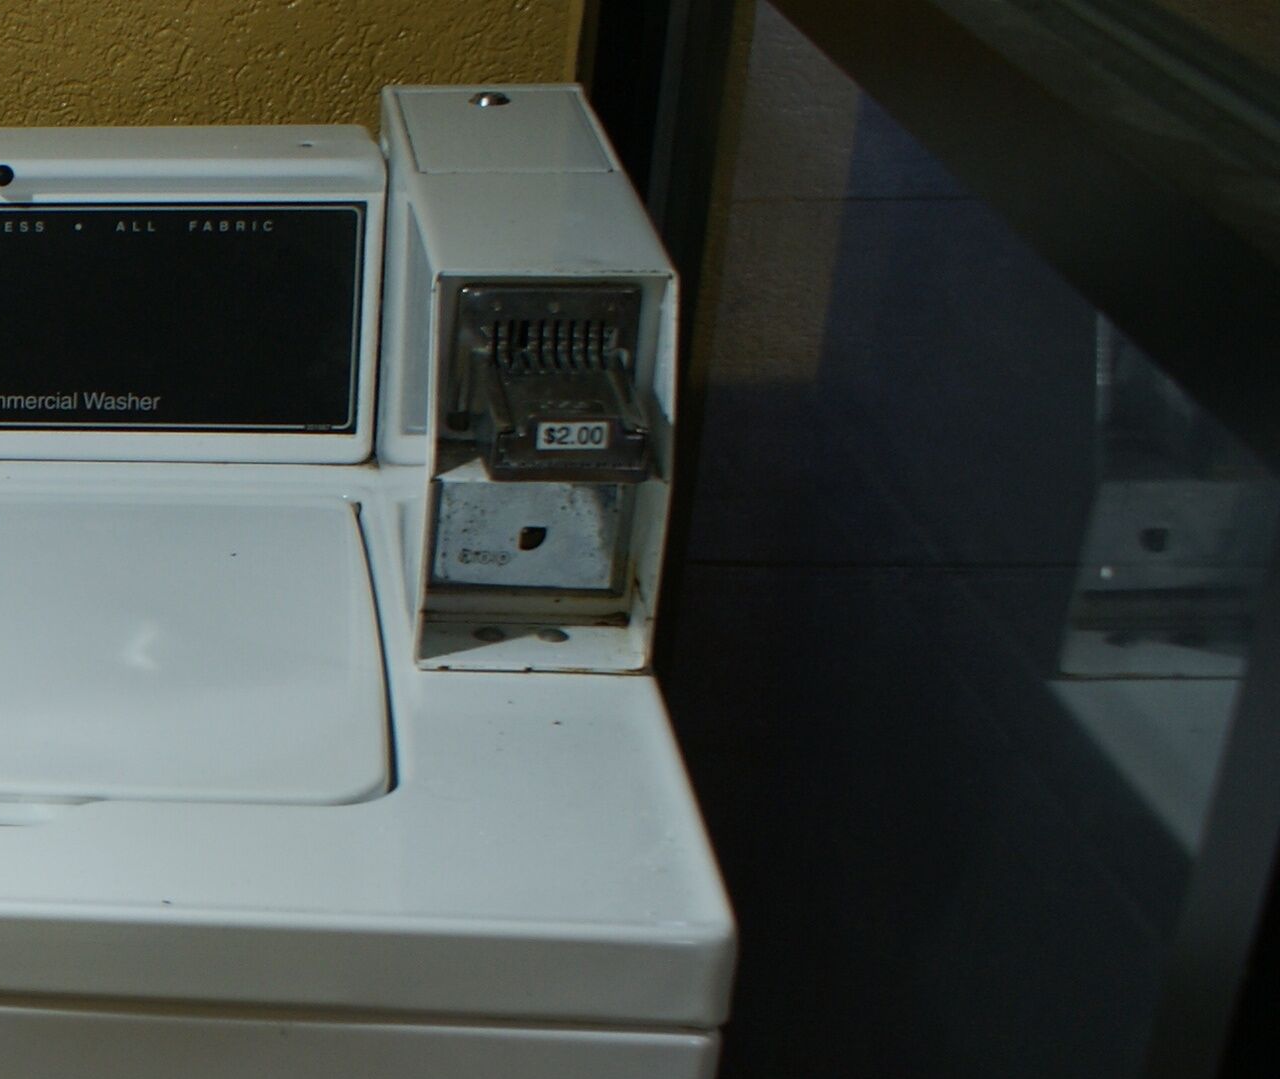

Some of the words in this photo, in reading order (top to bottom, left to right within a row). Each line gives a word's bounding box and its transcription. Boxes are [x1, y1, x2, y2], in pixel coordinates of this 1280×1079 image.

[115, 220, 157, 233] ALL
[188, 220, 276, 233] FABRIC
[84, 391, 161, 411] Washer
[543, 426, 604, 446] $2.00
